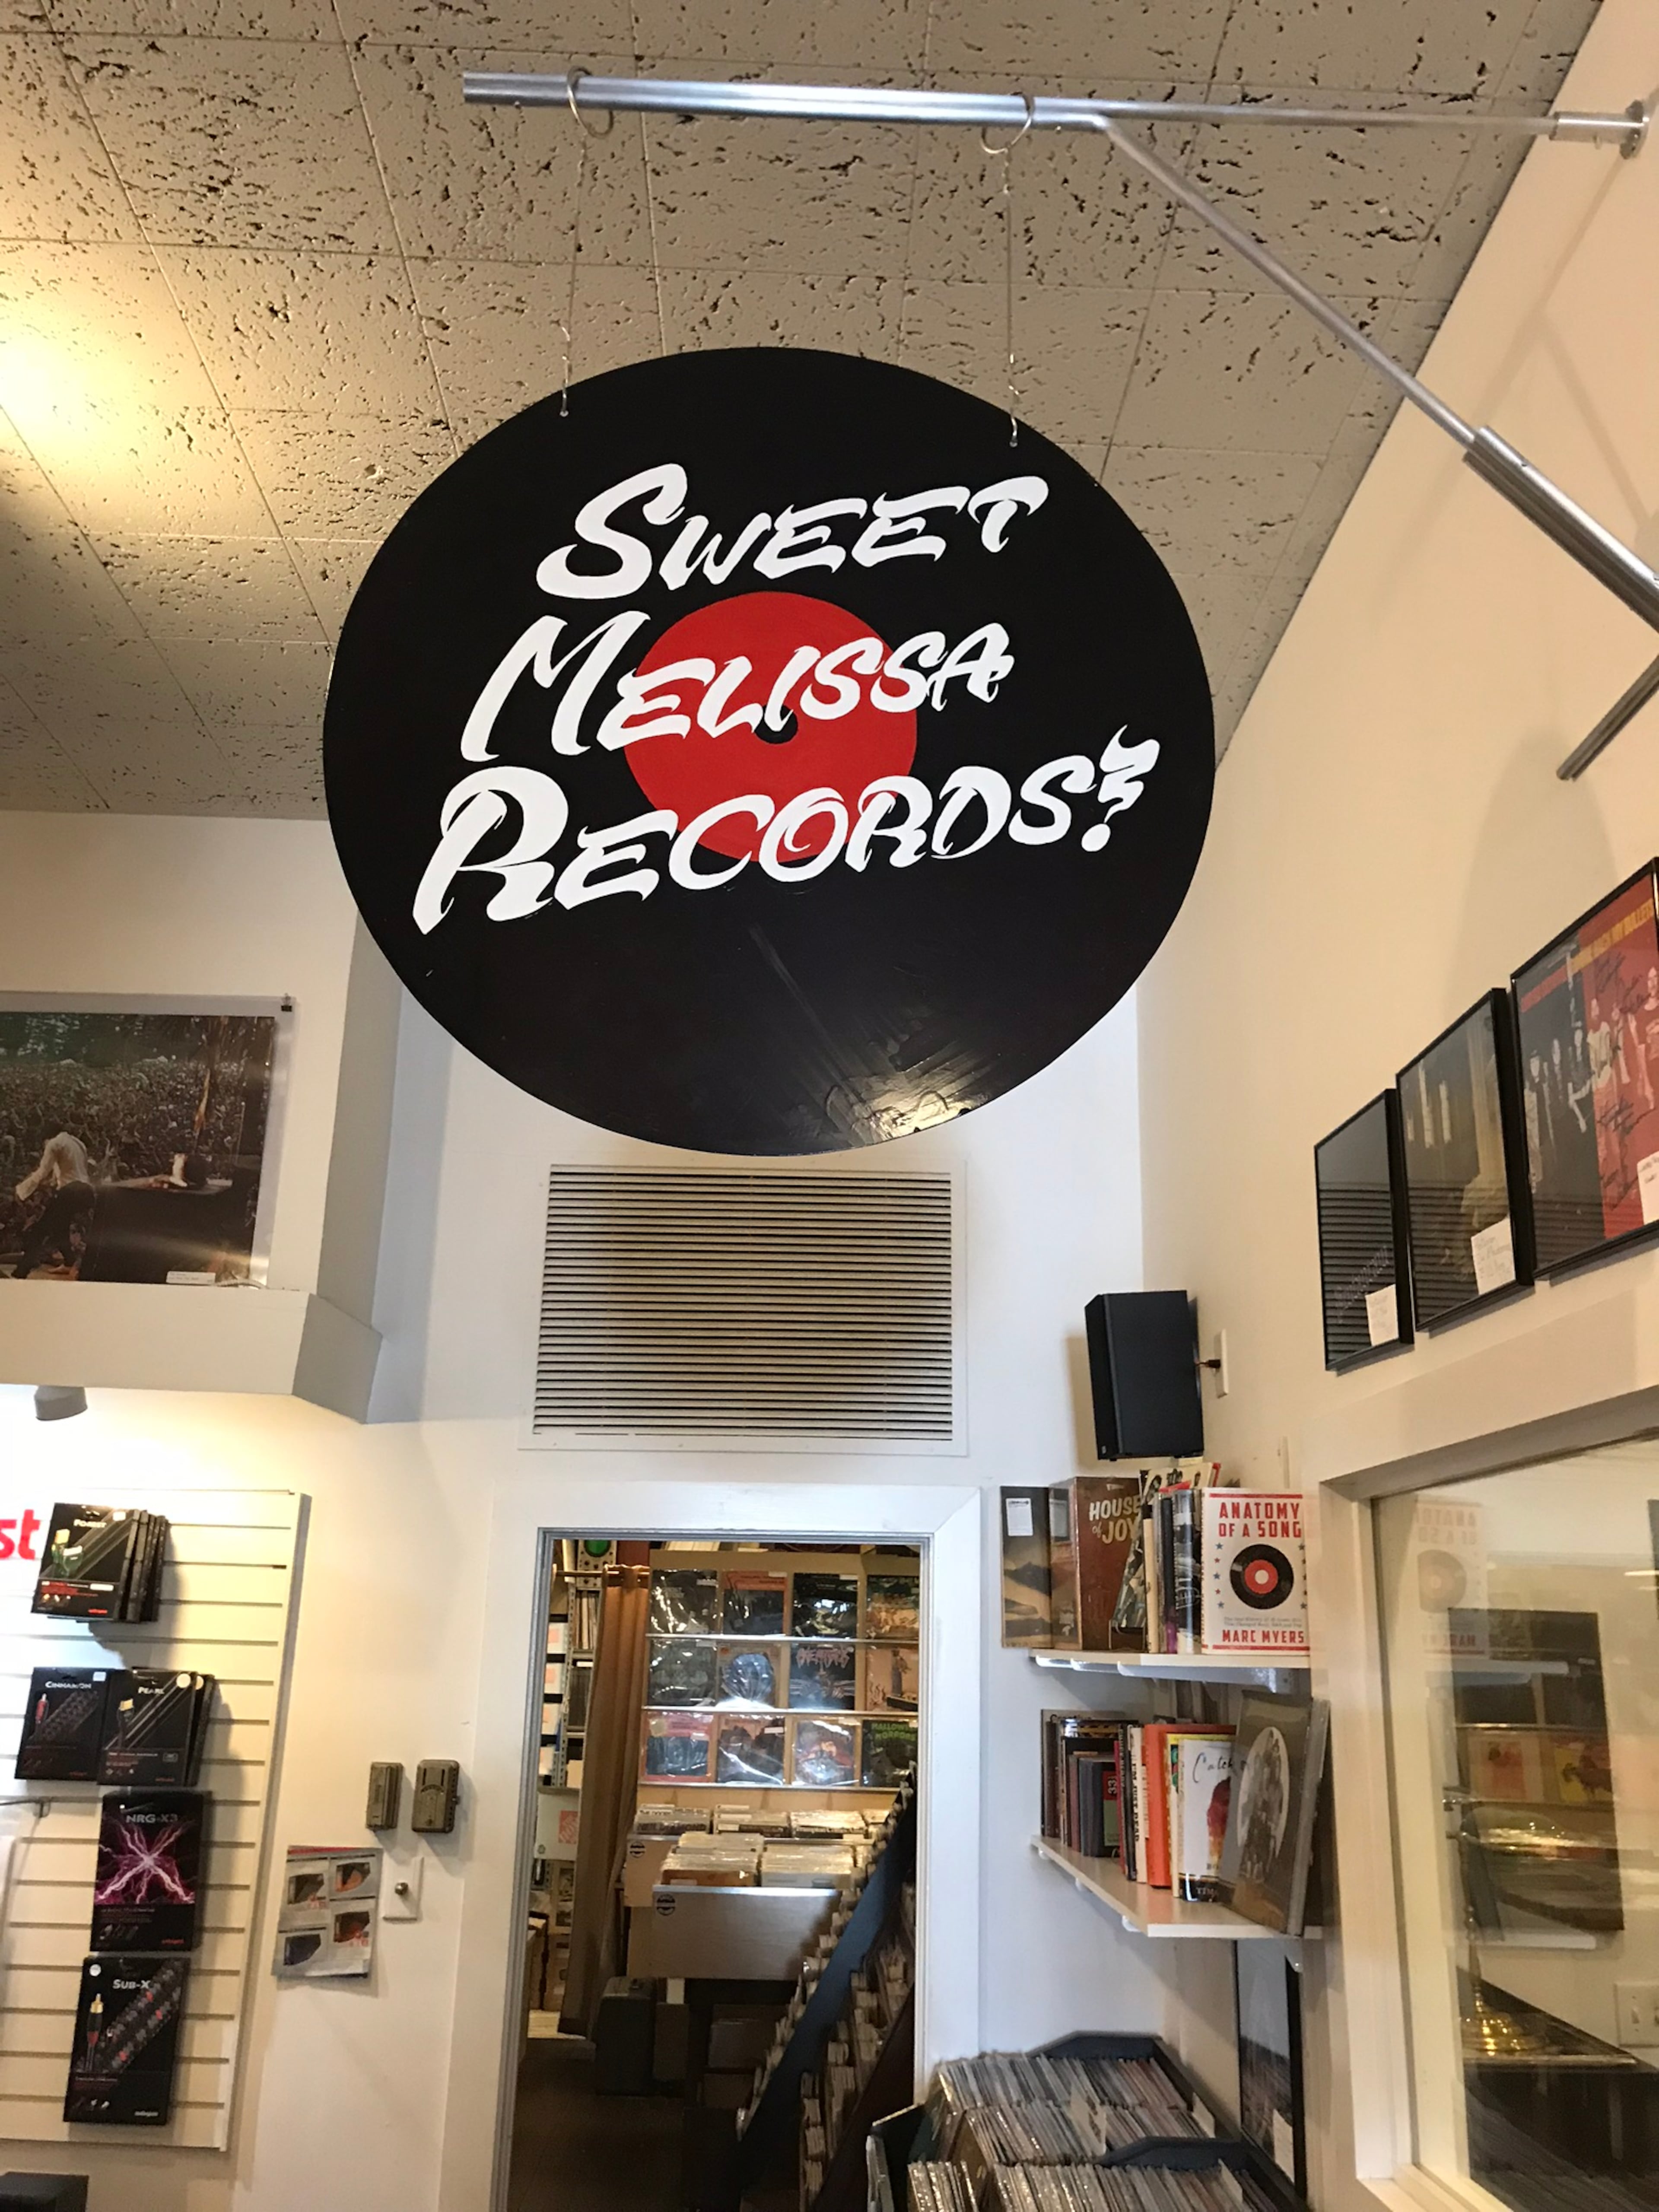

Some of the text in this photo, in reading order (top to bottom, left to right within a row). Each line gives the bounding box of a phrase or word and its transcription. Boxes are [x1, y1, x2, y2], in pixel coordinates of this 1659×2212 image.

[536, 463, 1049, 600] SWEET
[460, 610, 1015, 762] MELISSA
[1089, 1494, 1141, 1521] HOUSE
[1219, 1502, 1300, 1520] ANATOMY
[1092, 1522, 1103, 1538] of
[1218, 1520, 1302, 1538] OF A SONG
[1222, 1629, 1305, 1643] MARC MYERS
